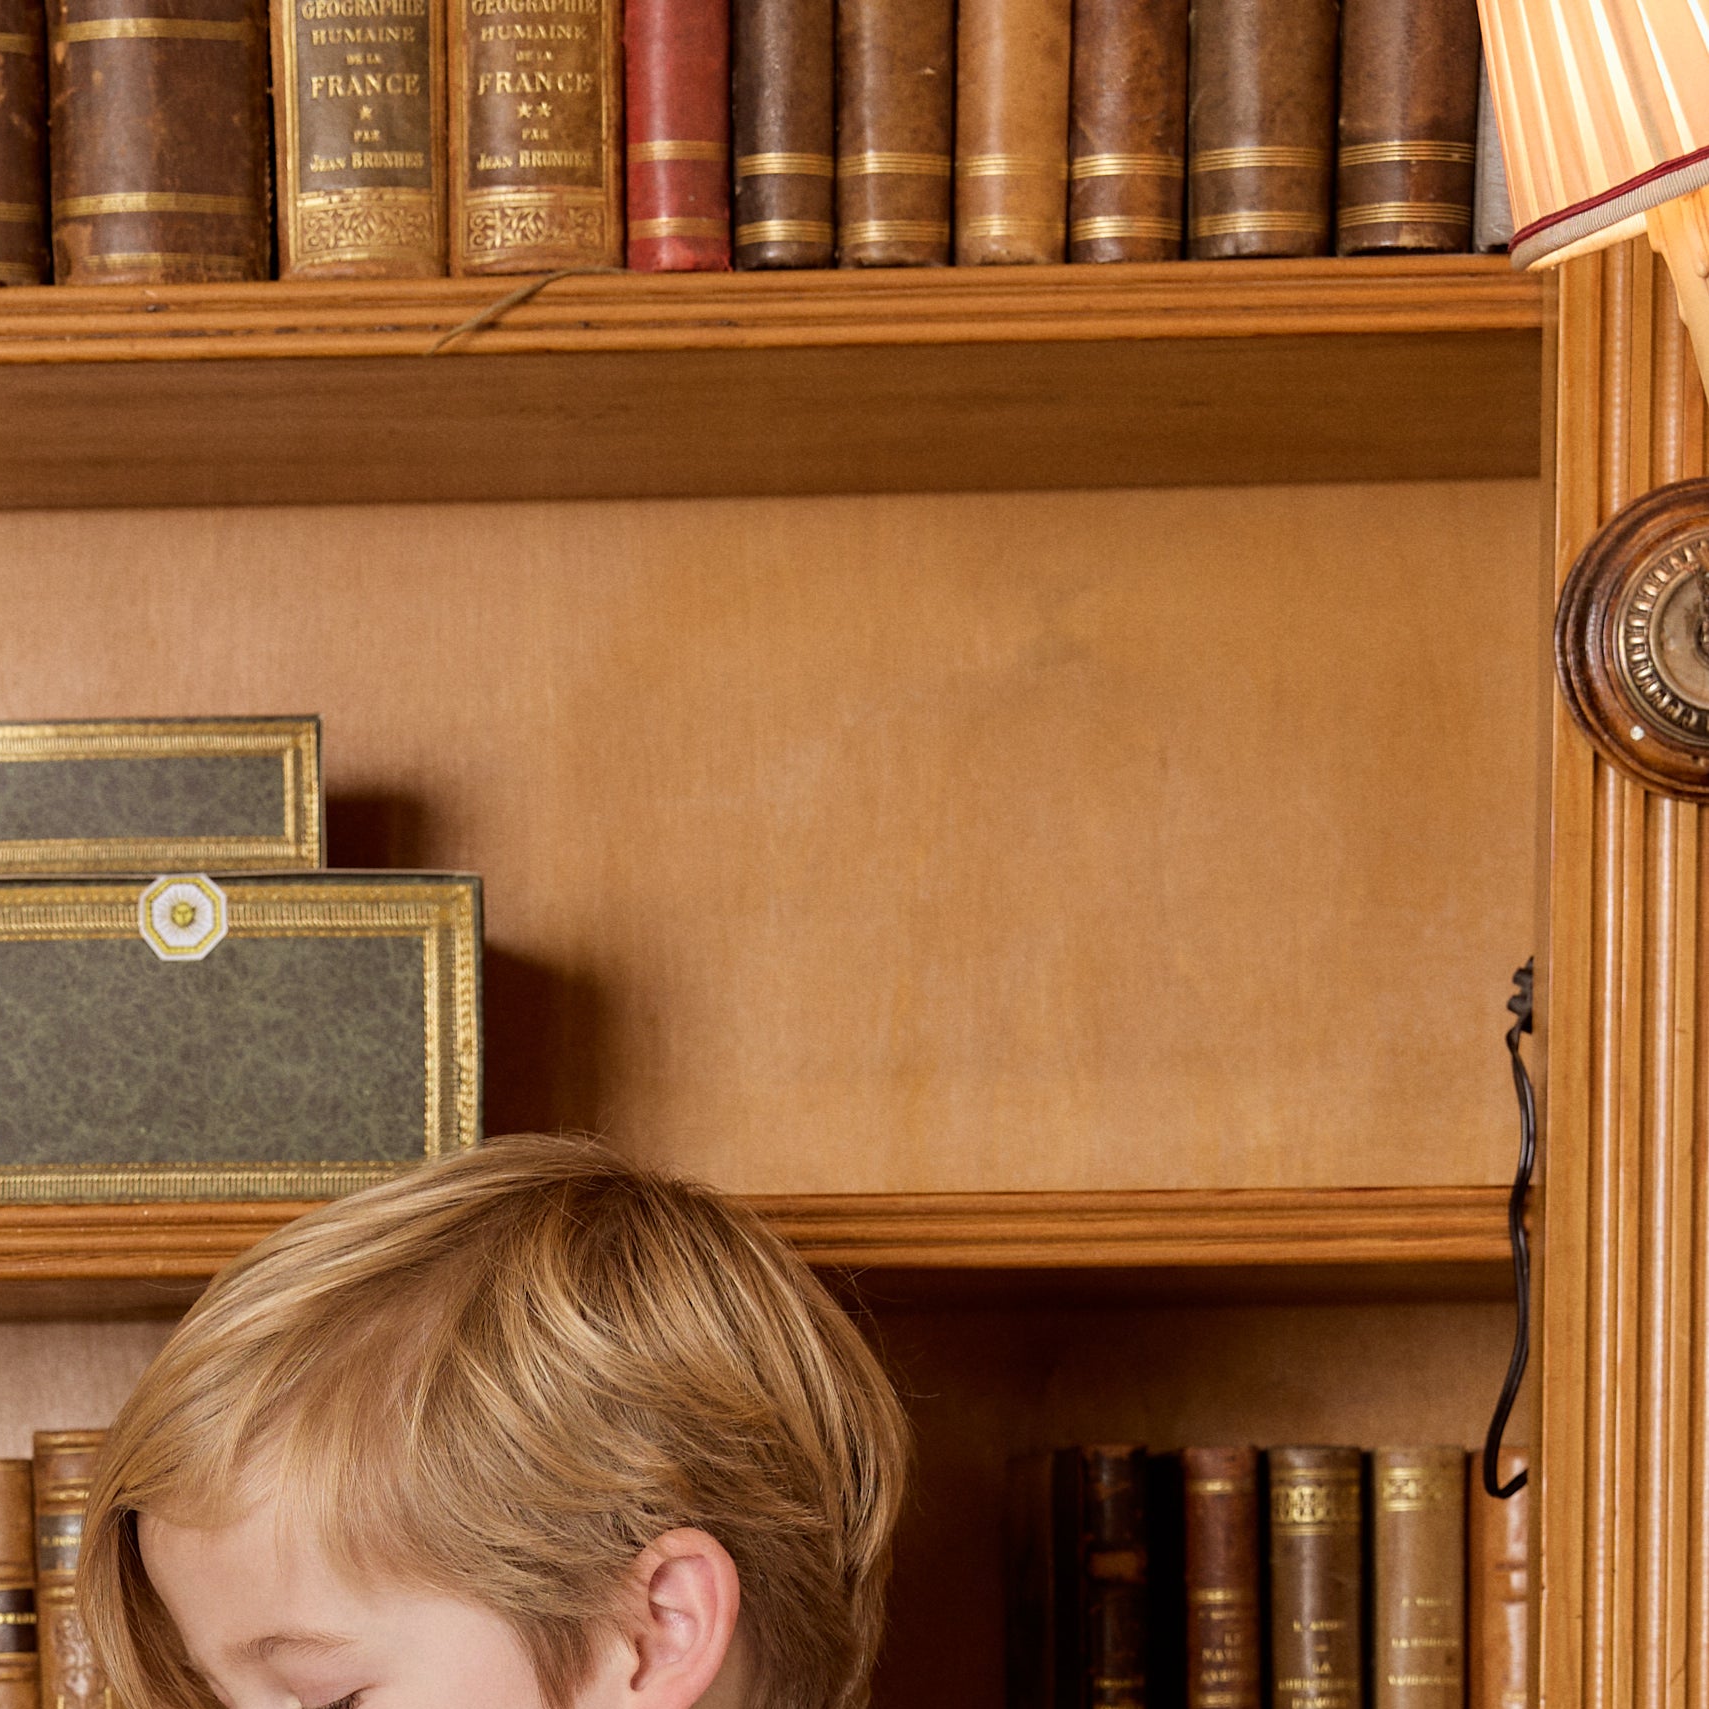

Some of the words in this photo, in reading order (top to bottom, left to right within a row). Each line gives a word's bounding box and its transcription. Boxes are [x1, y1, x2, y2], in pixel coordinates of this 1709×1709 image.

[311, 26, 415, 45] HUMAINE
[481, 24, 587, 42] HUMAINE
[346, 53, 363, 65] DE
[366, 53, 382, 64] LA
[515, 51, 533, 62] DE
[537, 51, 553, 62] LA
[310, 73, 421, 99] FRANCE
[478, 71, 593, 95] FRANCE
[354, 130, 380, 143] PAR
[521, 129, 549, 140] PAR
[351, 151, 424, 169] BRUNHES
